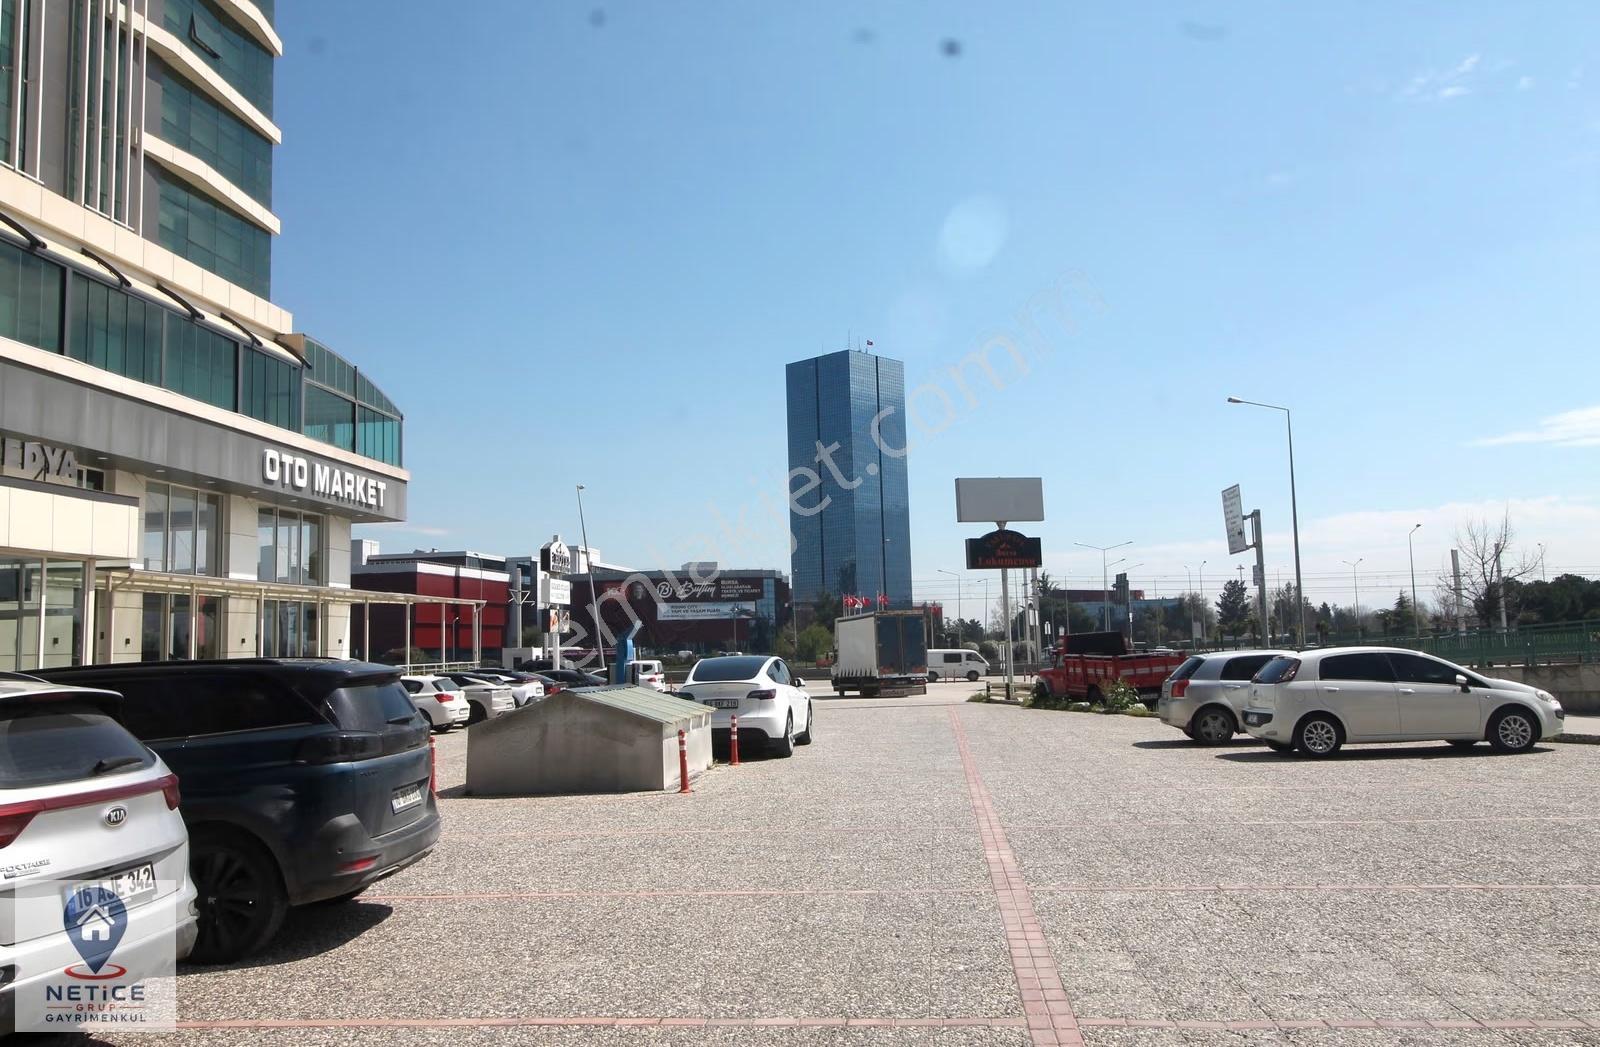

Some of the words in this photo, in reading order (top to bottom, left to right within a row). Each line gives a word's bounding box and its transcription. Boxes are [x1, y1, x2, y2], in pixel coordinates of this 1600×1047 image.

[264, 449, 308, 488] OTO
[313, 462, 387, 507] MARKET
[110, 810, 126, 822] KIA
[78, 887, 93, 909] 16
[127, 867, 153, 893] 342
